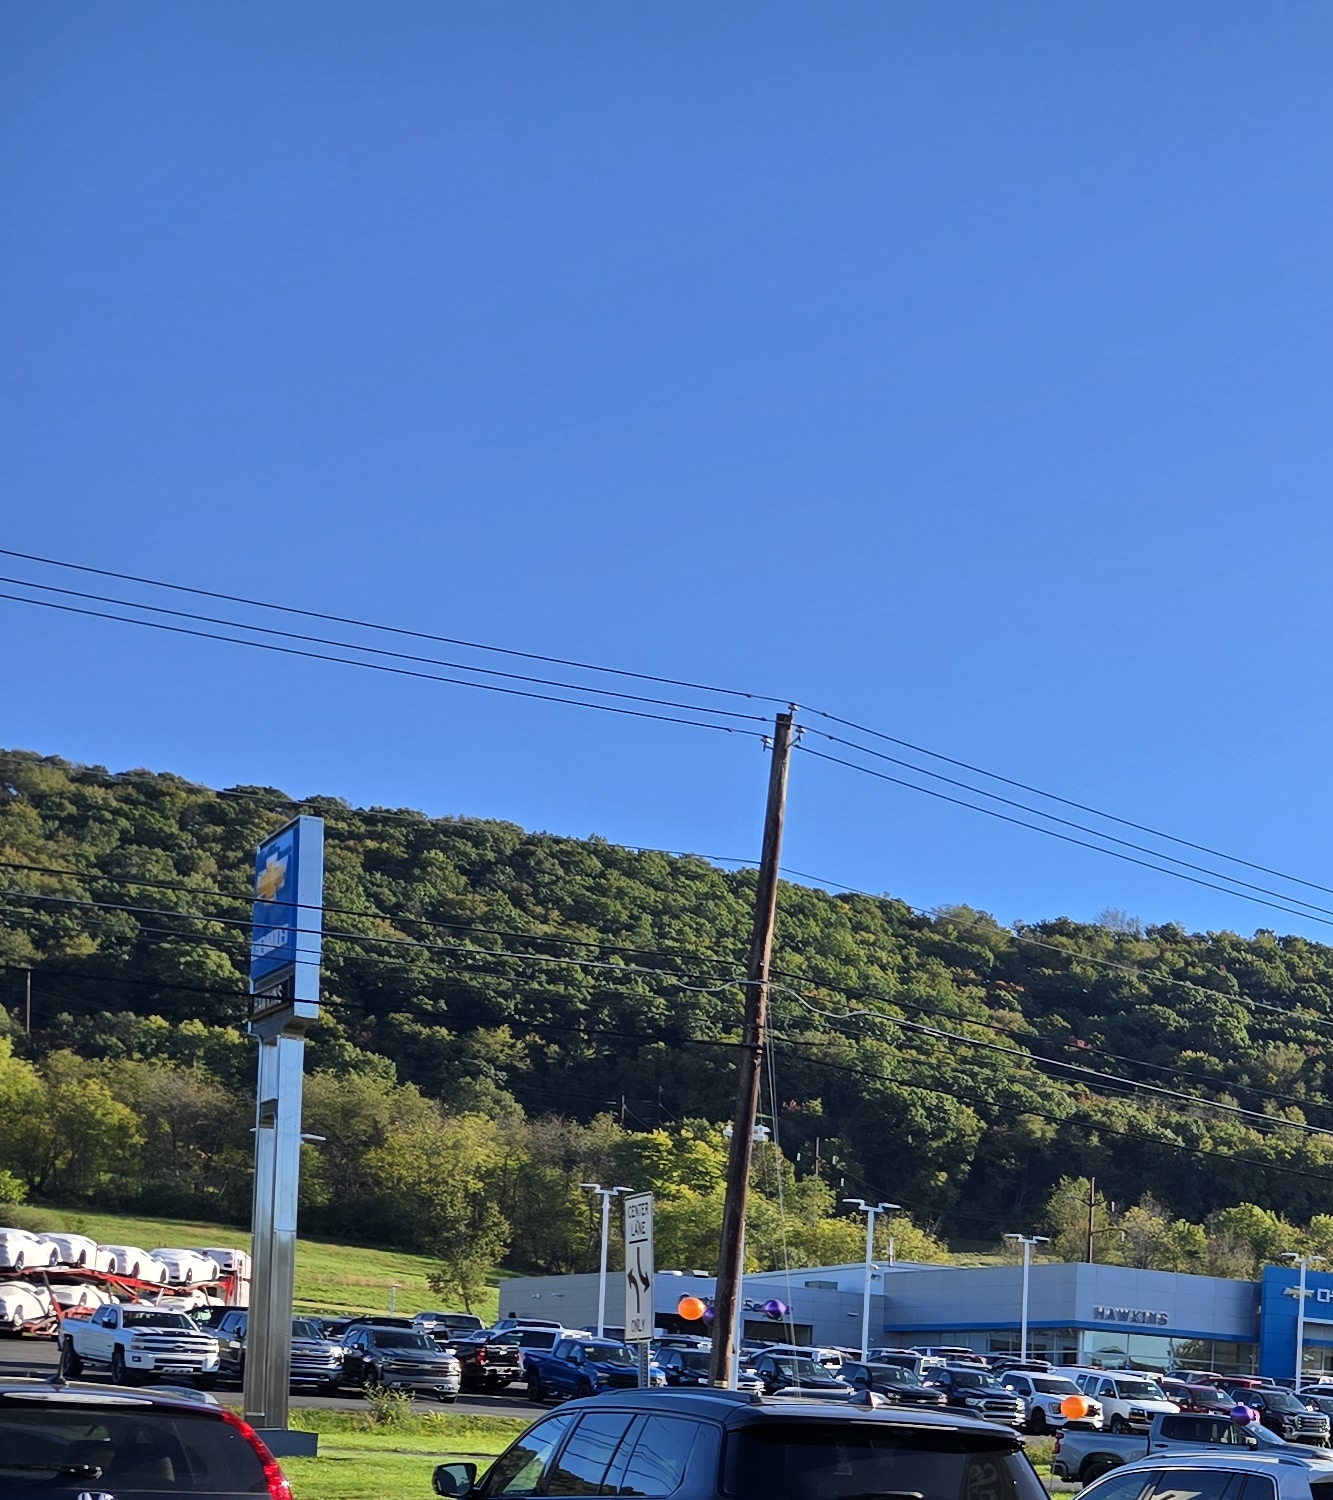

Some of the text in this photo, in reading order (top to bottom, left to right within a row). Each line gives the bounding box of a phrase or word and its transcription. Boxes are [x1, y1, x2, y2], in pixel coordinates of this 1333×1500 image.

[628, 1202, 649, 1218] CENTER
[631, 1220, 646, 1236] LANE
[1093, 1306, 1169, 1326] HAWKINS
[631, 1318, 646, 1333] ONLY
